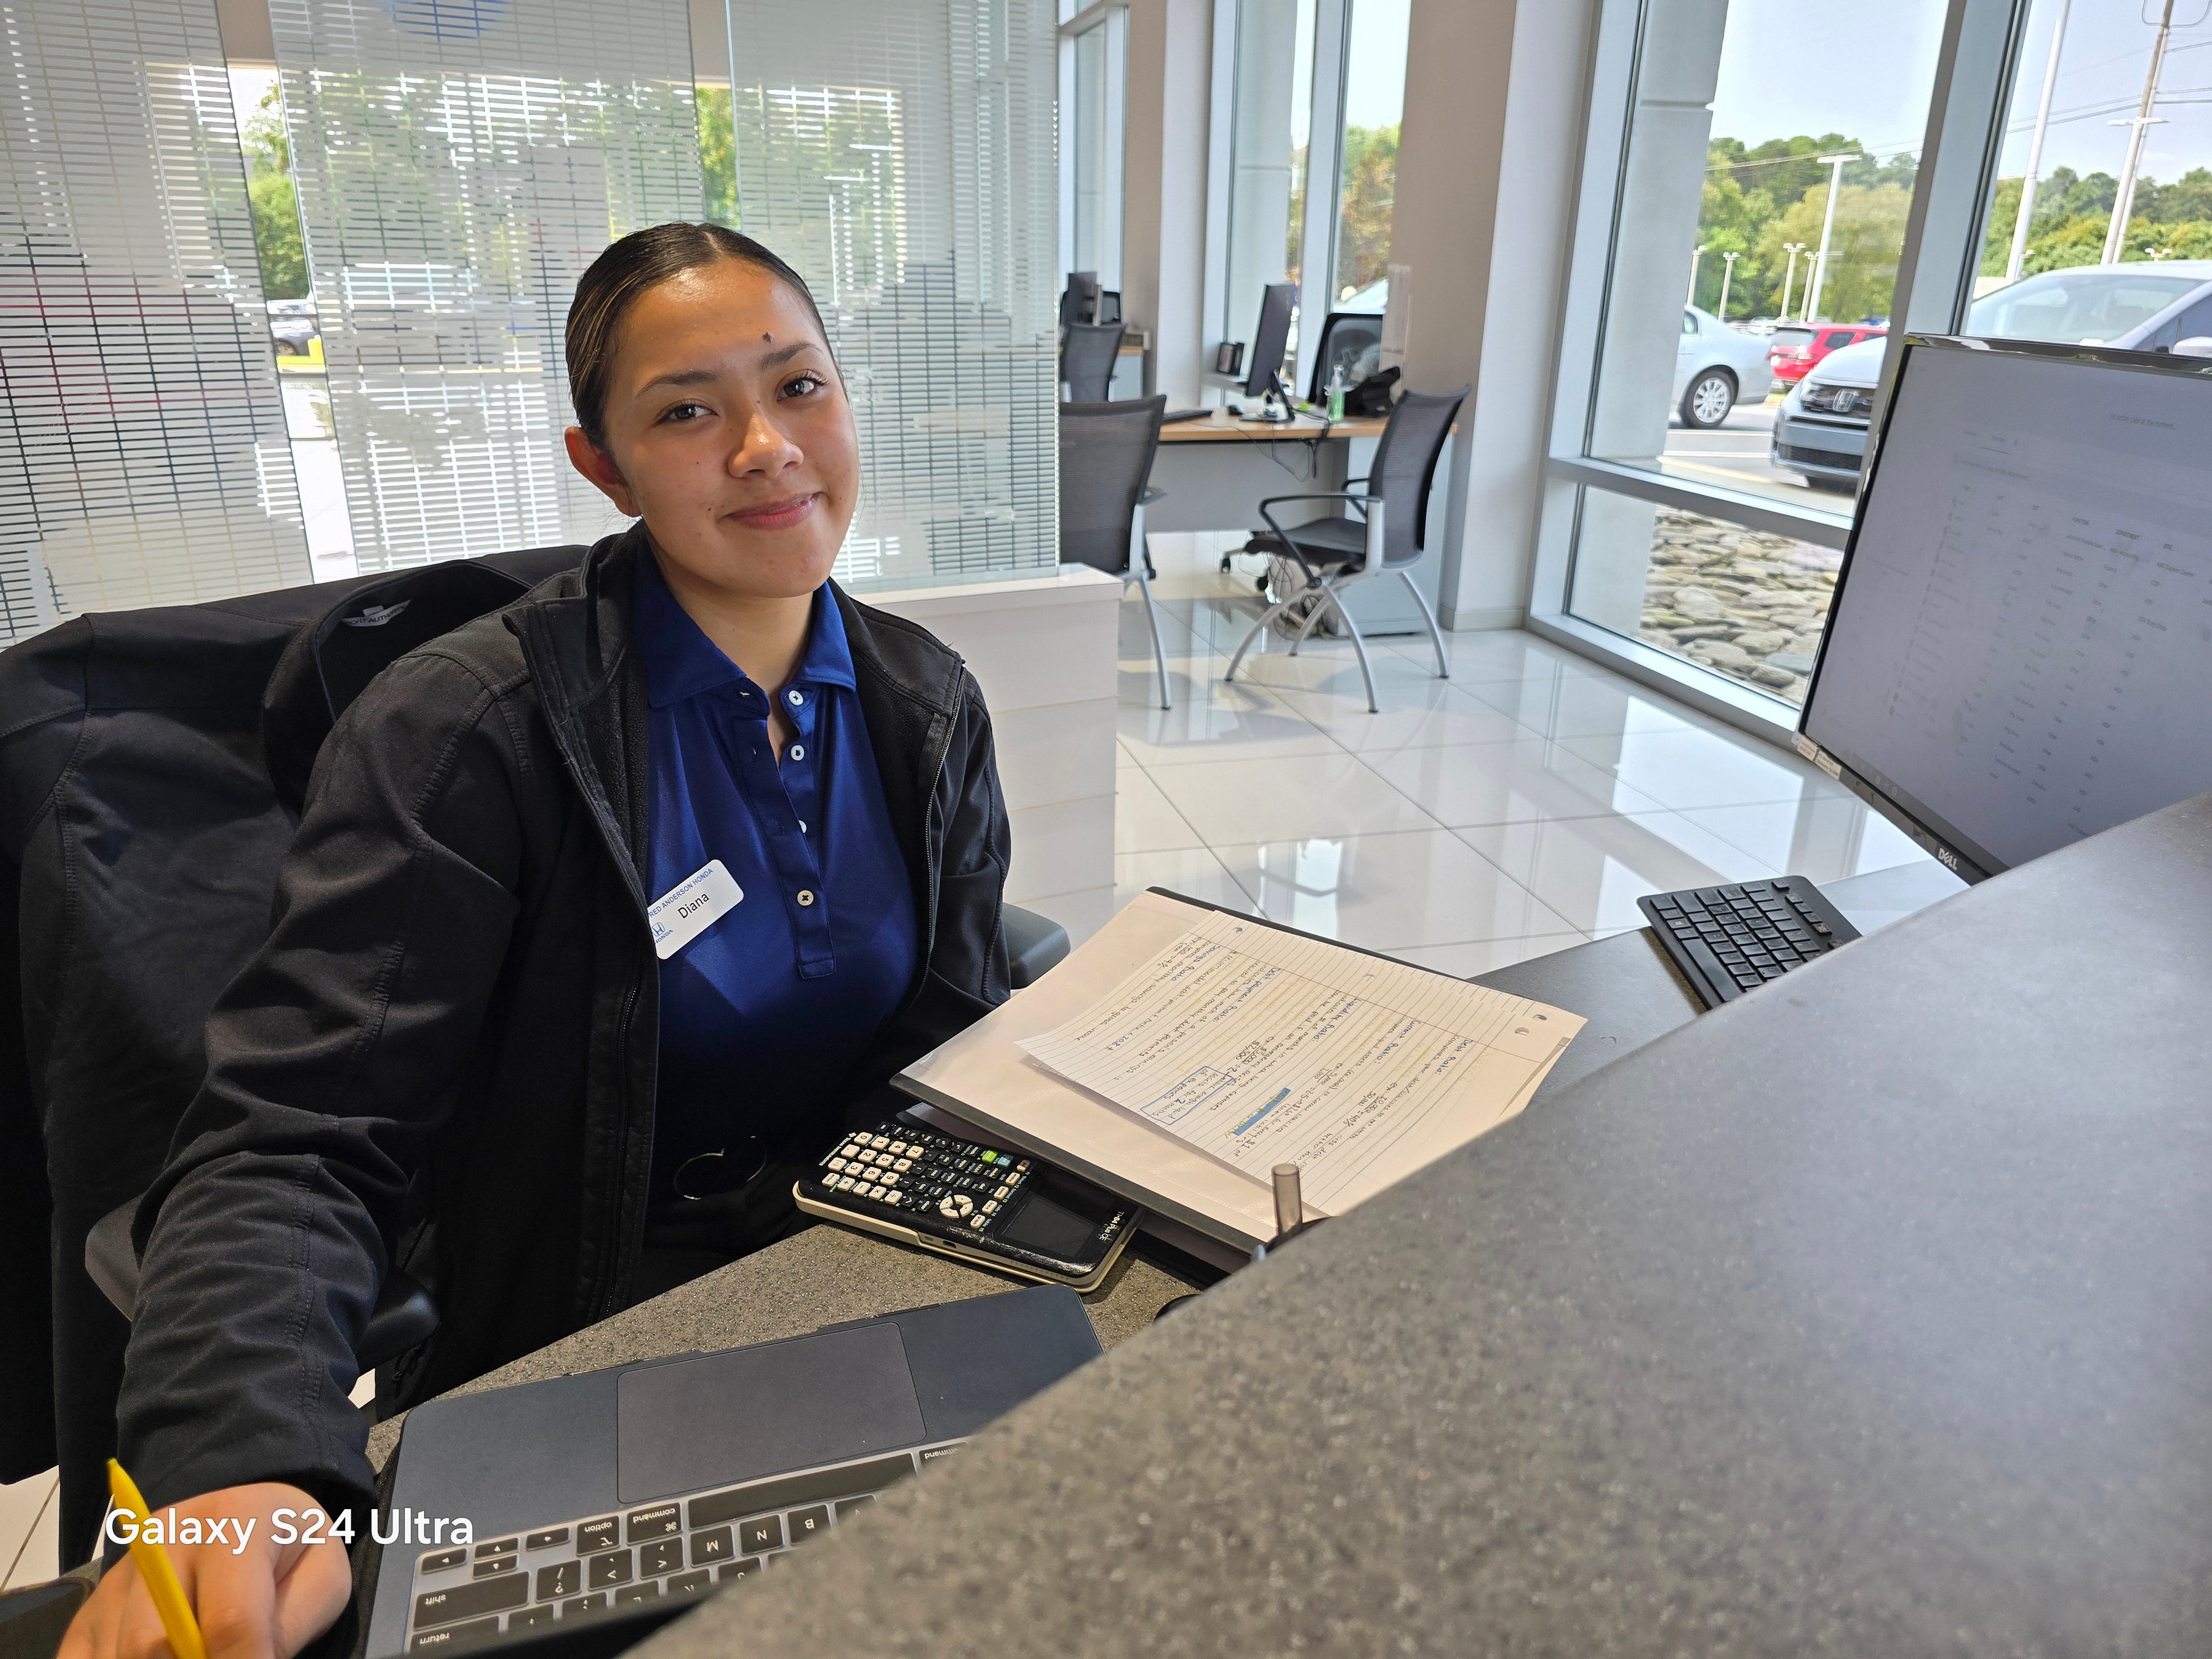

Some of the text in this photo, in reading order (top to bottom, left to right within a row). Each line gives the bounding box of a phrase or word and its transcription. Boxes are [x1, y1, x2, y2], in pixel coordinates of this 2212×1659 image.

[1938, 848, 1957, 870] DELL
[661, 883, 693, 909] ANDERSON
[692, 869, 713, 885] HONDA
[677, 894, 709, 919] Diana
[1154, 960, 1183, 982] monthly
[1262, 965, 1281, 979] Debt
[1130, 984, 1155, 1003] savings
[1214, 987, 1228, 996] pay
[1227, 988, 1240, 999] how
[1237, 979, 1262, 1002] payment
[1189, 998, 1215, 1017] monthly
[1209, 1001, 1223, 1014] much
[1099, 1011, 1120, 1025] gross
[1173, 1019, 1190, 1032] debt
[1074, 1027, 1095, 1041] income
[1286, 1031, 1308, 1050] months
[1139, 1034, 1170, 1056] payments
[1454, 1037, 1473, 1052] Debt
[1355, 1050, 1371, 1066] assets
[1257, 1060, 1276, 1073] which
[1164, 1066, 1208, 1099] of expenses
[1227, 1070, 1250, 1086] arises
[1238, 1076, 1259, 1087] living
[1209, 1091, 1237, 1110] expenses
[1151, 1098, 1174, 1120] months
[1167, 1107, 1185, 1119] liquid
[1366, 1118, 1376, 1127] net
[1251, 1126, 1269, 1138] every
[1348, 1126, 1366, 1139] worth
[1297, 1133, 1333, 1160] better than
[1312, 1147, 1326, 1159] debt
[1103, 1223, 1117, 1233] Plus
[633, 1508, 676, 1524] command
[585, 1521, 613, 1533] option
[805, 1519, 815, 1530] B
[757, 1530, 768, 1541] N
[706, 1540, 718, 1552] M
[425, 1594, 447, 1605] shift
[419, 1632, 450, 1645] return
